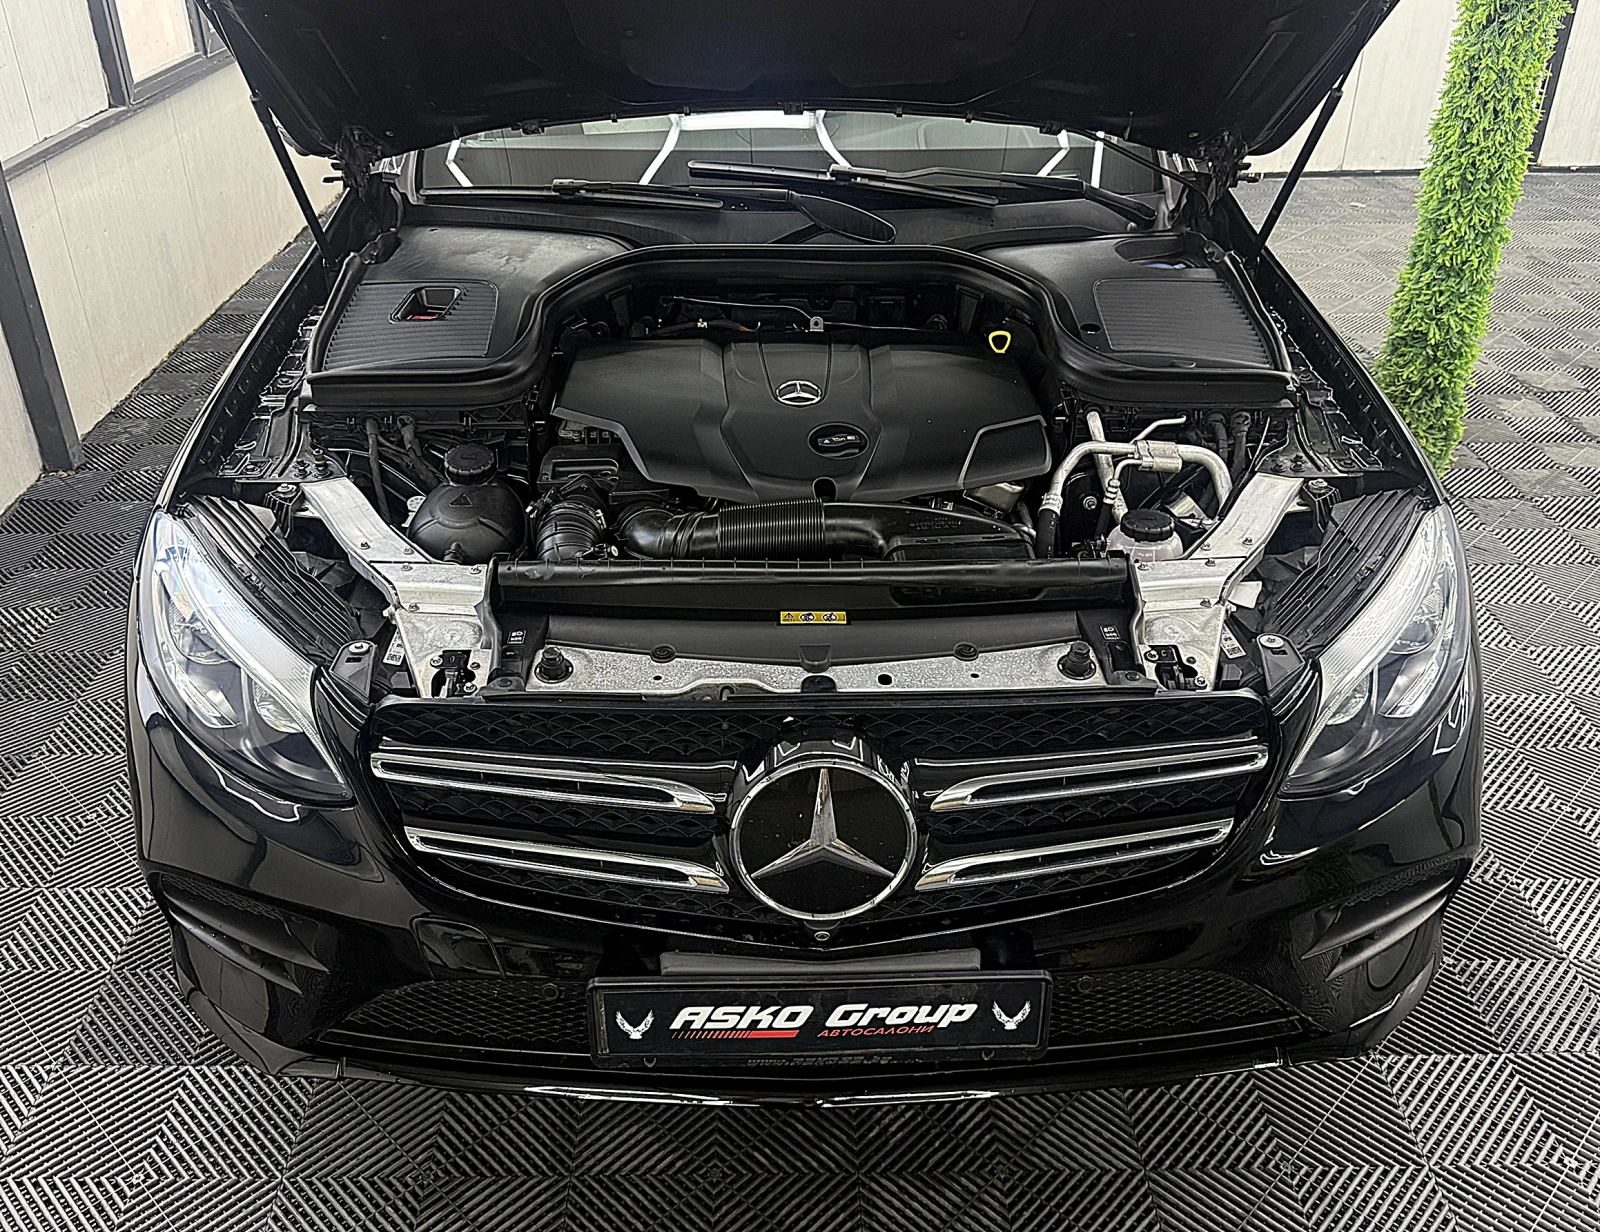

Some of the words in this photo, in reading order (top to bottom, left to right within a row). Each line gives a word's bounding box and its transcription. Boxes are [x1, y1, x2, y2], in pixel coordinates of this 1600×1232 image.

[671, 1005, 815, 1029] ASKO
[825, 1002, 977, 1028] Group
[818, 1024, 934, 1038] АВТОСАЛОНИ
